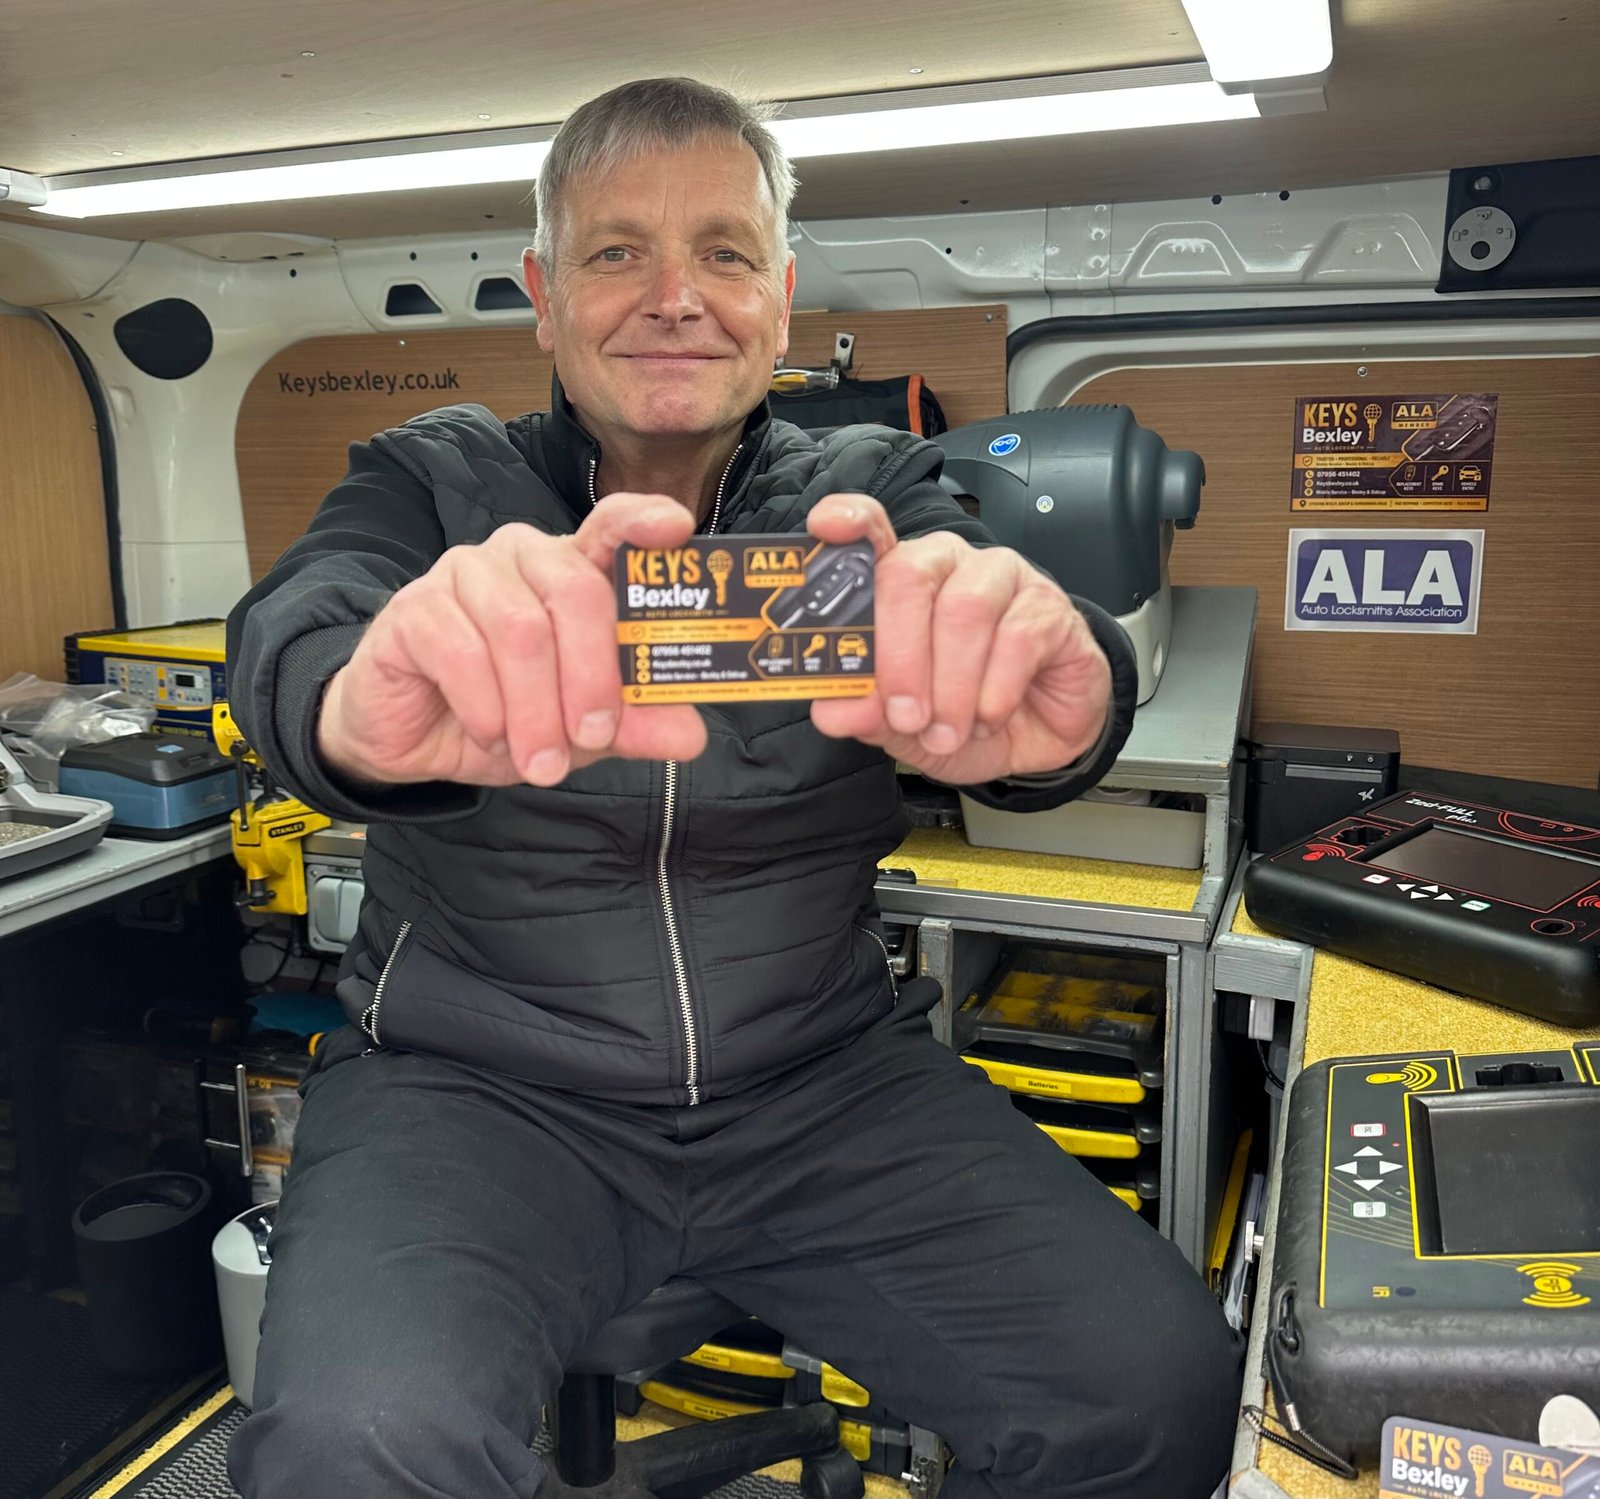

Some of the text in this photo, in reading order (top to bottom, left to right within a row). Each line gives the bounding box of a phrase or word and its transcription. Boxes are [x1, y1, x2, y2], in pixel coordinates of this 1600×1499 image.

[278, 368, 460, 397] Keysbexley.co.uk
[1304, 402, 1358, 427] KEYS
[1396, 404, 1433, 417] ALA
[1302, 427, 1362, 445] Bexley
[626, 548, 700, 585] KEYS
[750, 551, 799, 570] ALA
[1301, 549, 1464, 606] ALA
[627, 583, 710, 610] Bexley
[1301, 605, 1462, 618] Auto Locksmiths Association
[271, 823, 303, 836] STANLEY
[1028, 1080, 1059, 1089] Batteries
[1393, 1426, 1462, 1470] KEYS
[1392, 1458, 1469, 1496] Bexley
[1509, 1454, 1556, 1479] ALA
